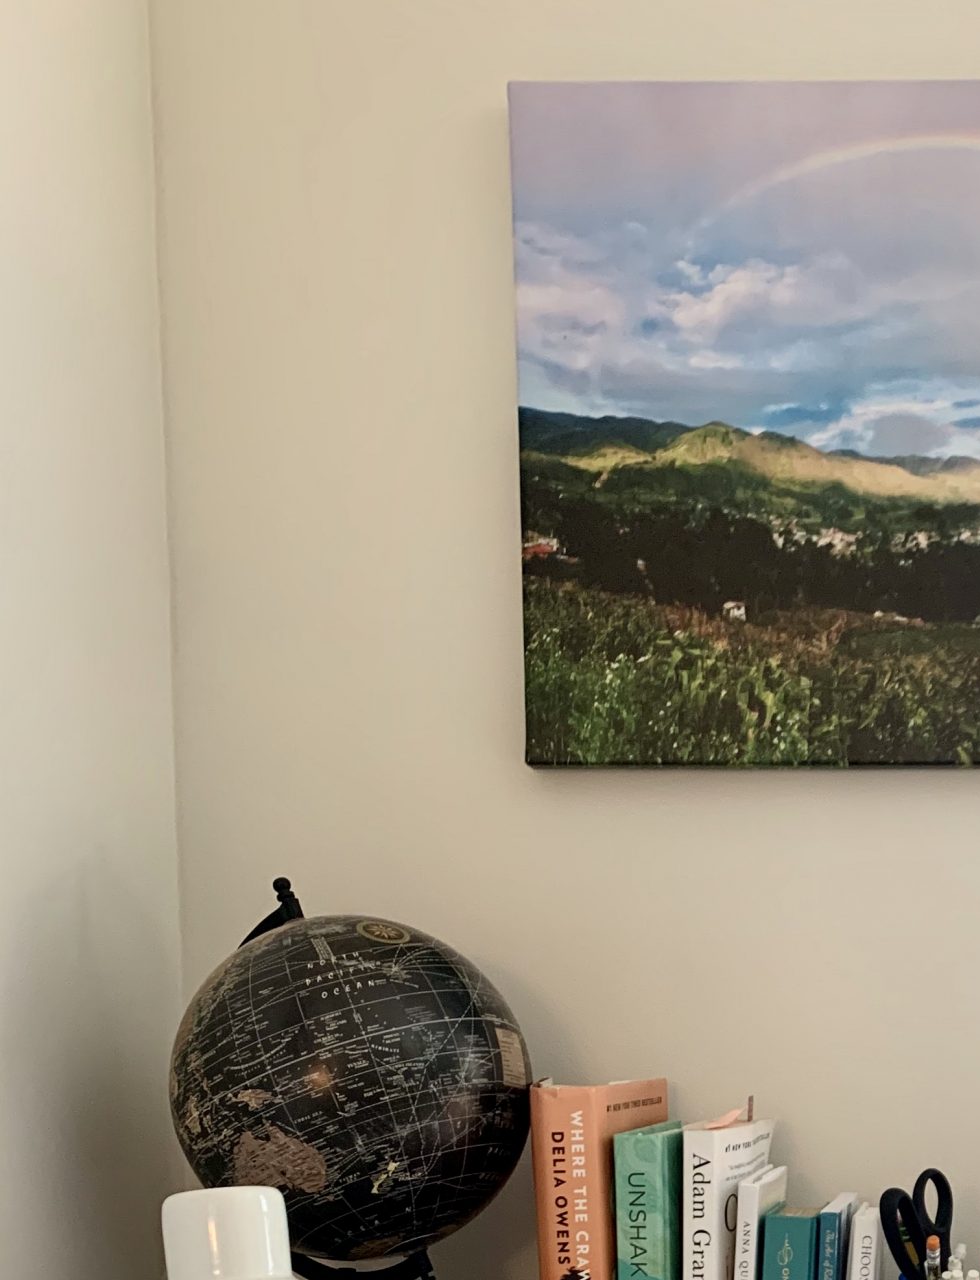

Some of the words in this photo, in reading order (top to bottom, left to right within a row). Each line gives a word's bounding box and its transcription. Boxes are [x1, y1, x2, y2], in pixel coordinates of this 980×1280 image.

[321, 979, 375, 998] OCEAN
[551, 1131, 567, 1188] DELIA
[570, 1110, 586, 1178] WHERE
[573, 1185, 588, 1223] THE
[692, 1153, 712, 1219] Adam
[555, 1195, 571, 1265] OWENS
[742, 1221, 751, 1255] ANNA
